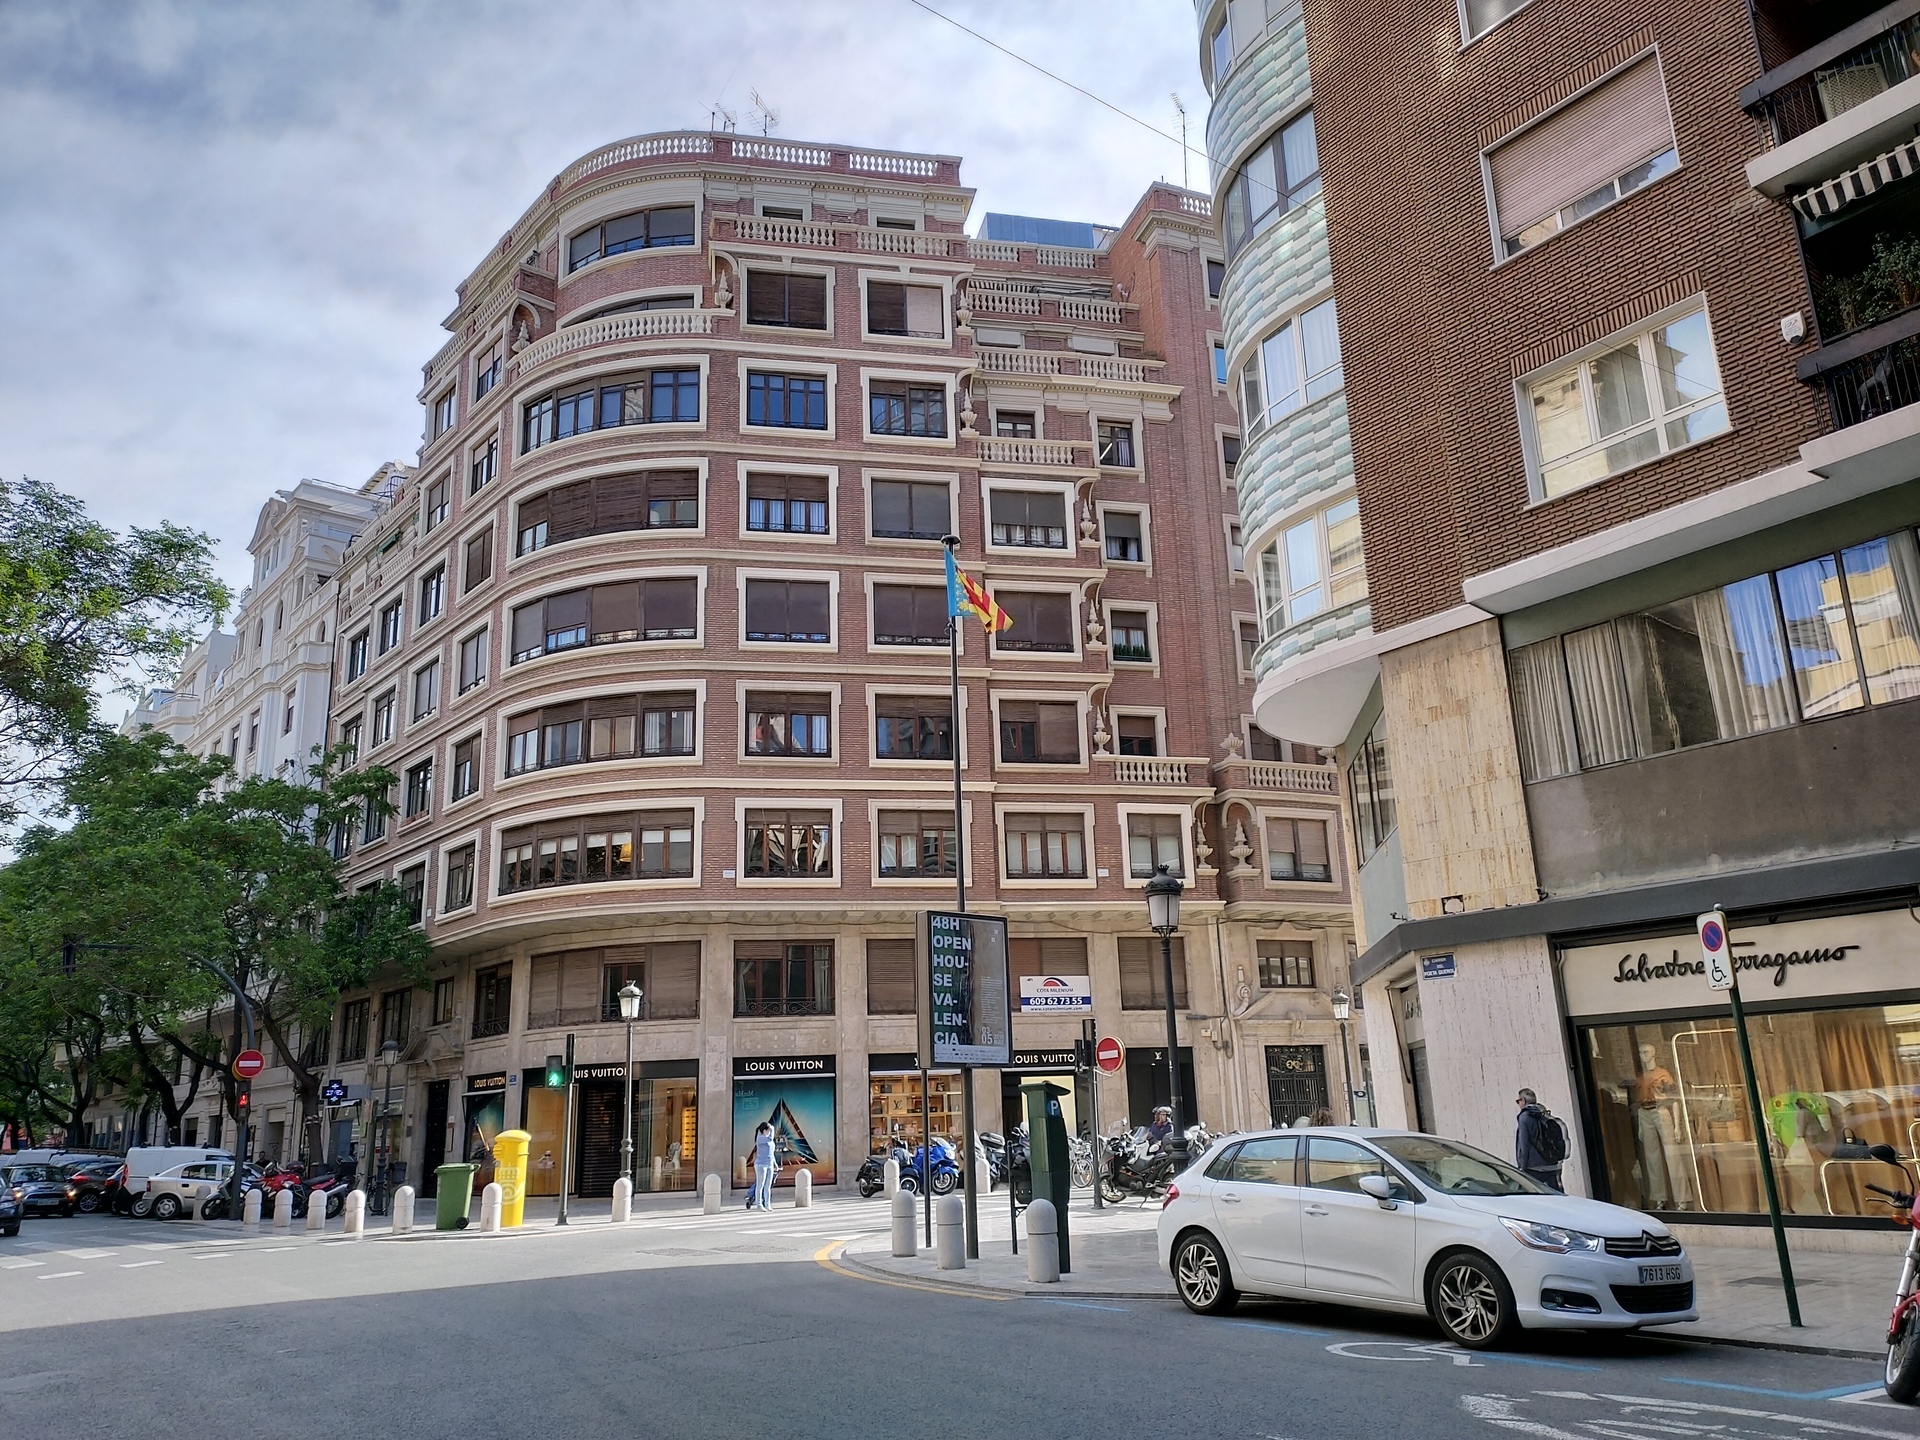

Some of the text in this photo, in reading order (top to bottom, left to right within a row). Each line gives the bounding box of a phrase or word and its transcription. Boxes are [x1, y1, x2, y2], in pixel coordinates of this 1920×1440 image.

[933, 916, 960, 930] 48H
[933, 935, 972, 950] OPEN
[933, 954, 969, 968] HOU-
[1614, 942, 1860, 986] Salvatore erragamo
[933, 973, 953, 987] SE
[933, 992, 958, 1006] VA-
[1029, 997, 1083, 1005] 609 62 73 55
[933, 1012, 967, 1026] LEN-
[934, 1031, 960, 1045] CIA
[981, 1033, 993, 1045] 05
[1042, 1053, 1076, 1063] VUITTO
[745, 1060, 824, 1071] LOUIS VUITTON
[573, 1069, 589, 1079] UIS
[474, 1078, 487, 1088] LOUIS
[487, 1076, 506, 1087] VUITTON
[1050, 1100, 1059, 1116] P
[1643, 1267, 1681, 1281] 7613 HSG
